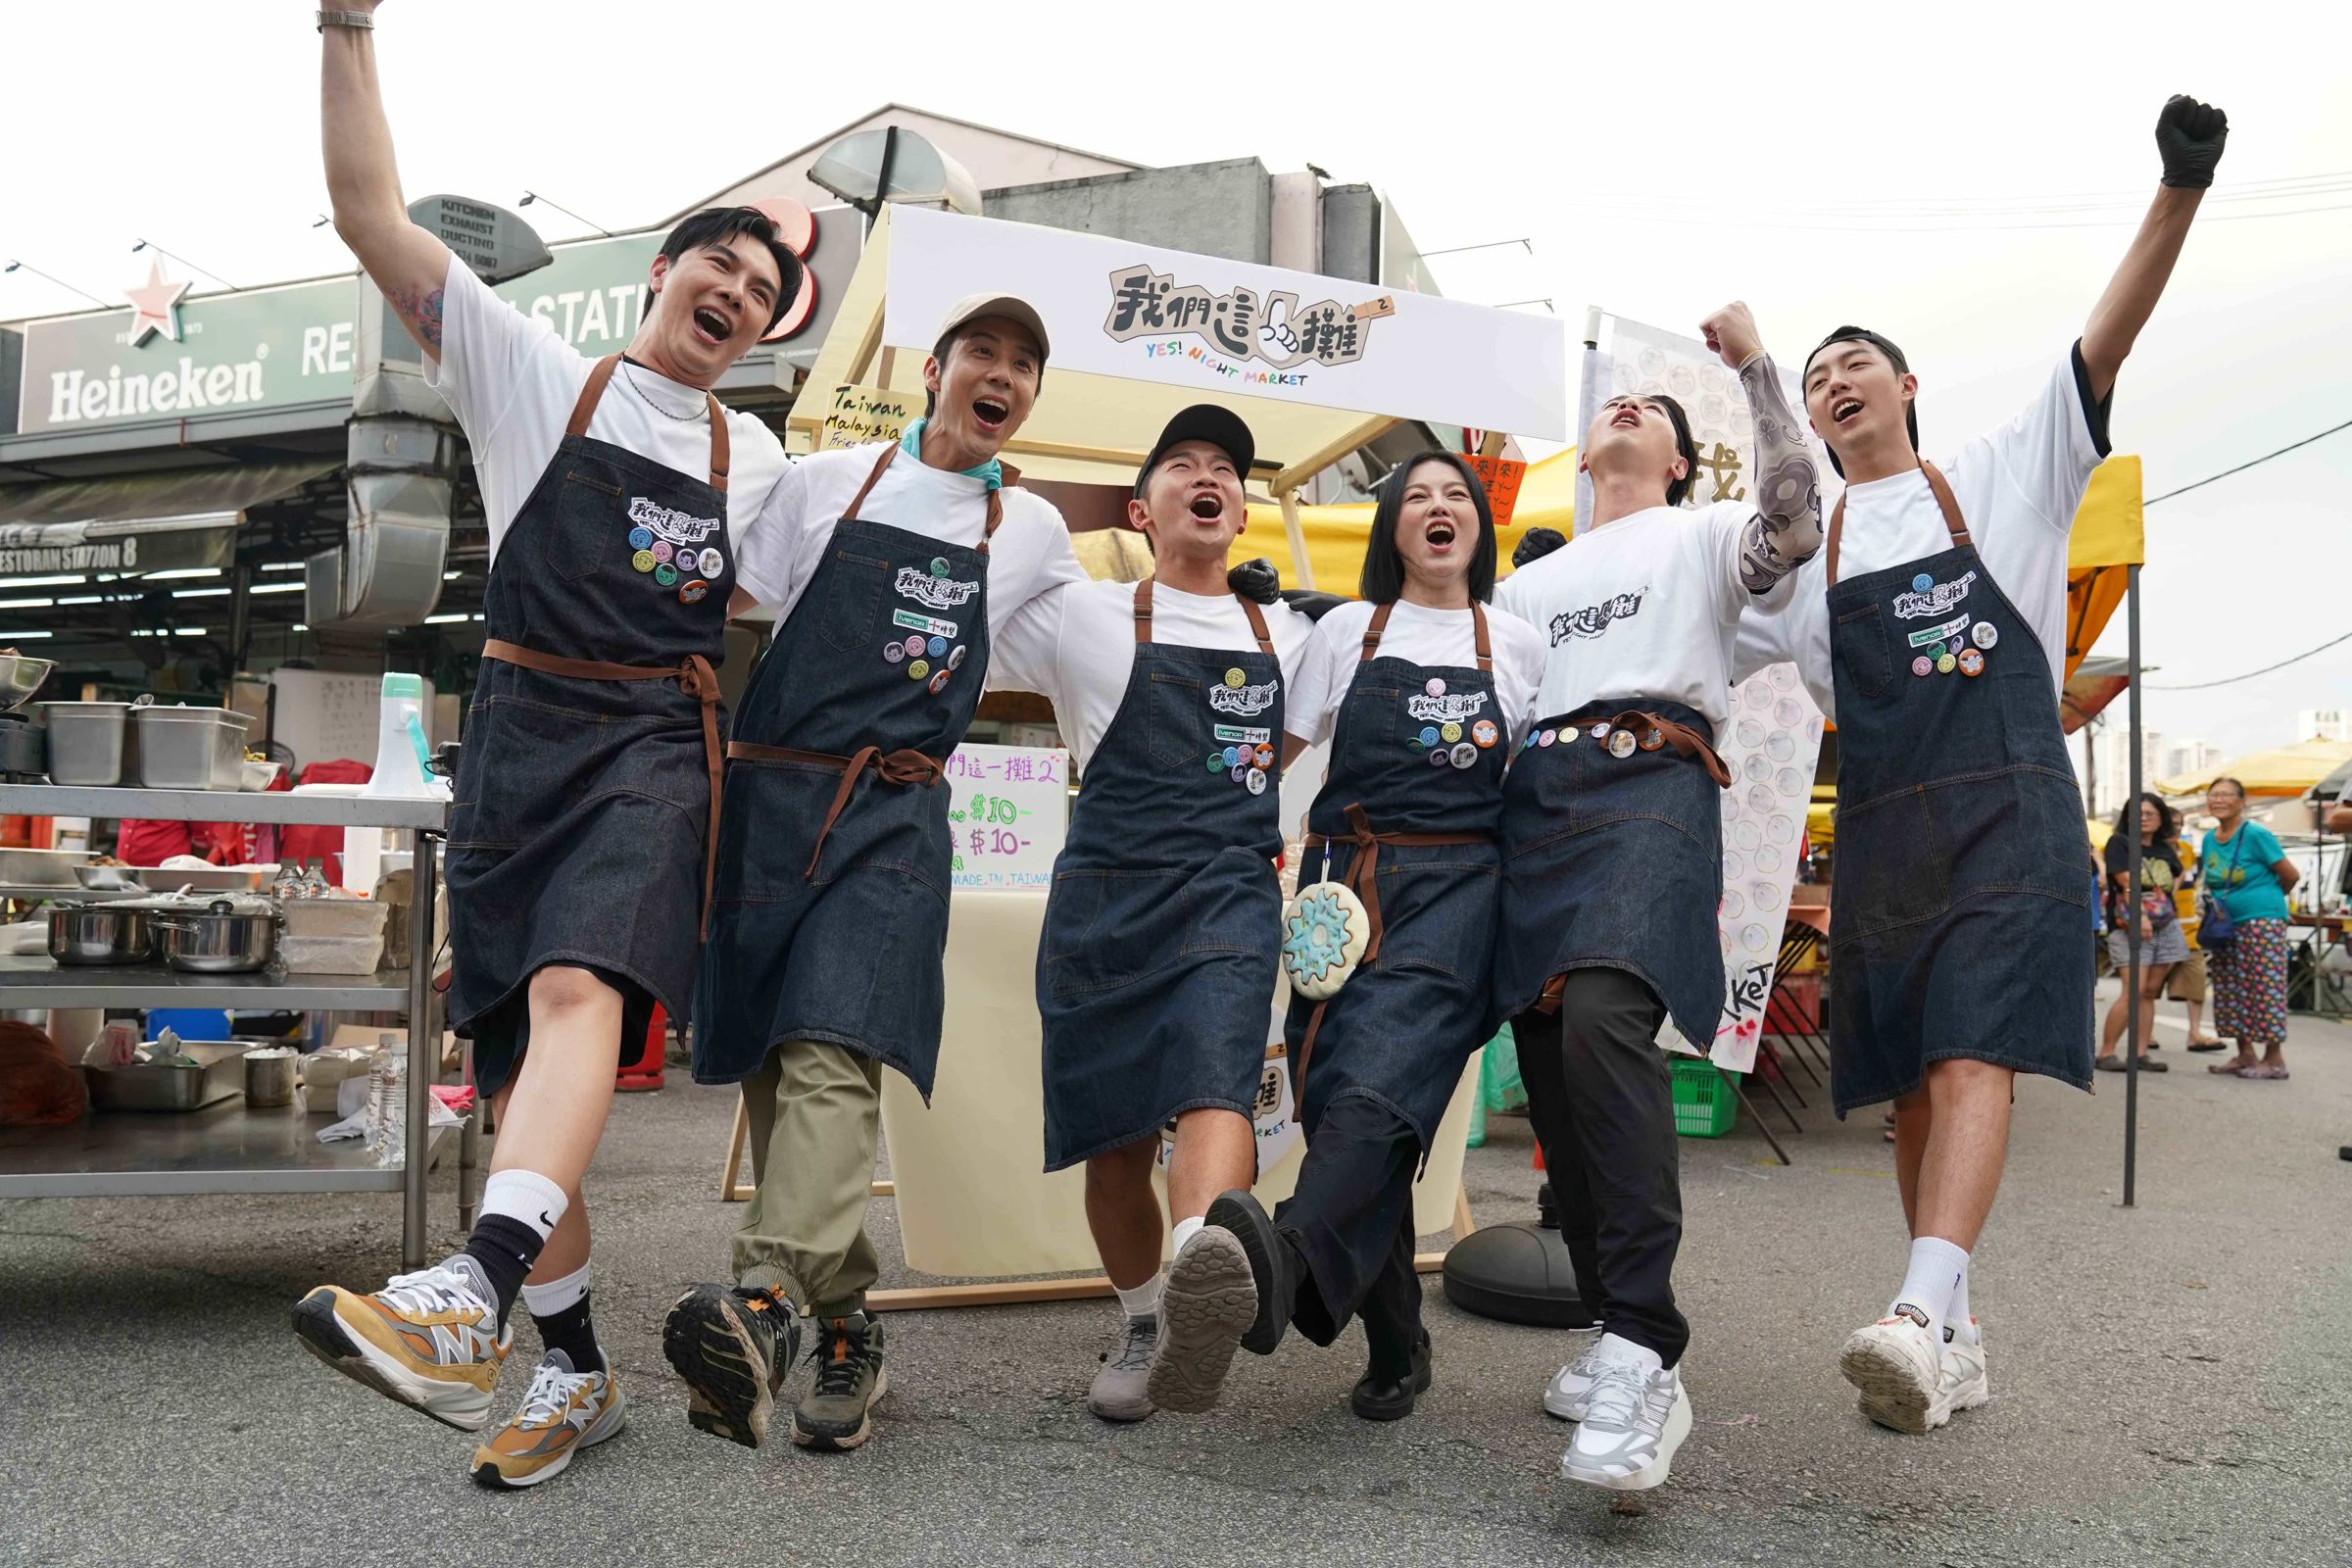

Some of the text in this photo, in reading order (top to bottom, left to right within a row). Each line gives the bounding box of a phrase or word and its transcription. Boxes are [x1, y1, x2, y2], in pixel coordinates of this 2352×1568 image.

[441, 214, 494, 235] EXHAUST
[442, 199, 495, 221] KITCHEN
[441, 229, 494, 250] DUCTING
[302, 321, 358, 376] RE
[1146, 340, 1308, 387] YES! NIGHT MARKET
[48, 356, 265, 422] Heineken
[835, 385, 906, 417] Taiwan
[825, 414, 903, 440] Malaysia
[62, 544, 120, 569] STATION
[122, 537, 137, 567] 8
